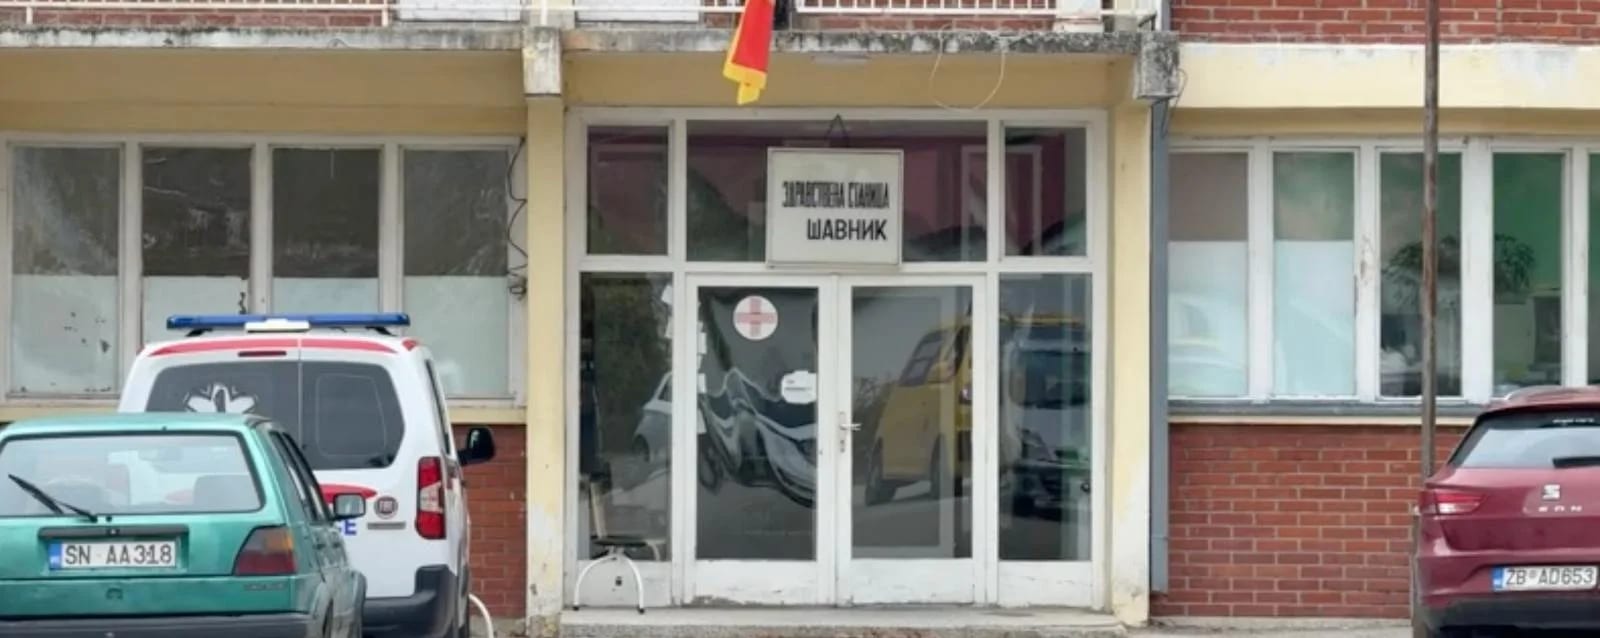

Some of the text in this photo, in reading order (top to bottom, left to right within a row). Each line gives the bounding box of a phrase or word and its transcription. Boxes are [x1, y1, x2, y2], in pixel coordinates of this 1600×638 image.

[848, 182, 889, 208] СТАНИЦА
[807, 218, 888, 240] ШАВНИК
[64, 544, 172, 565] SN AA318
[1506, 569, 1527, 585] ZB
[1537, 567, 1594, 585] AD653
